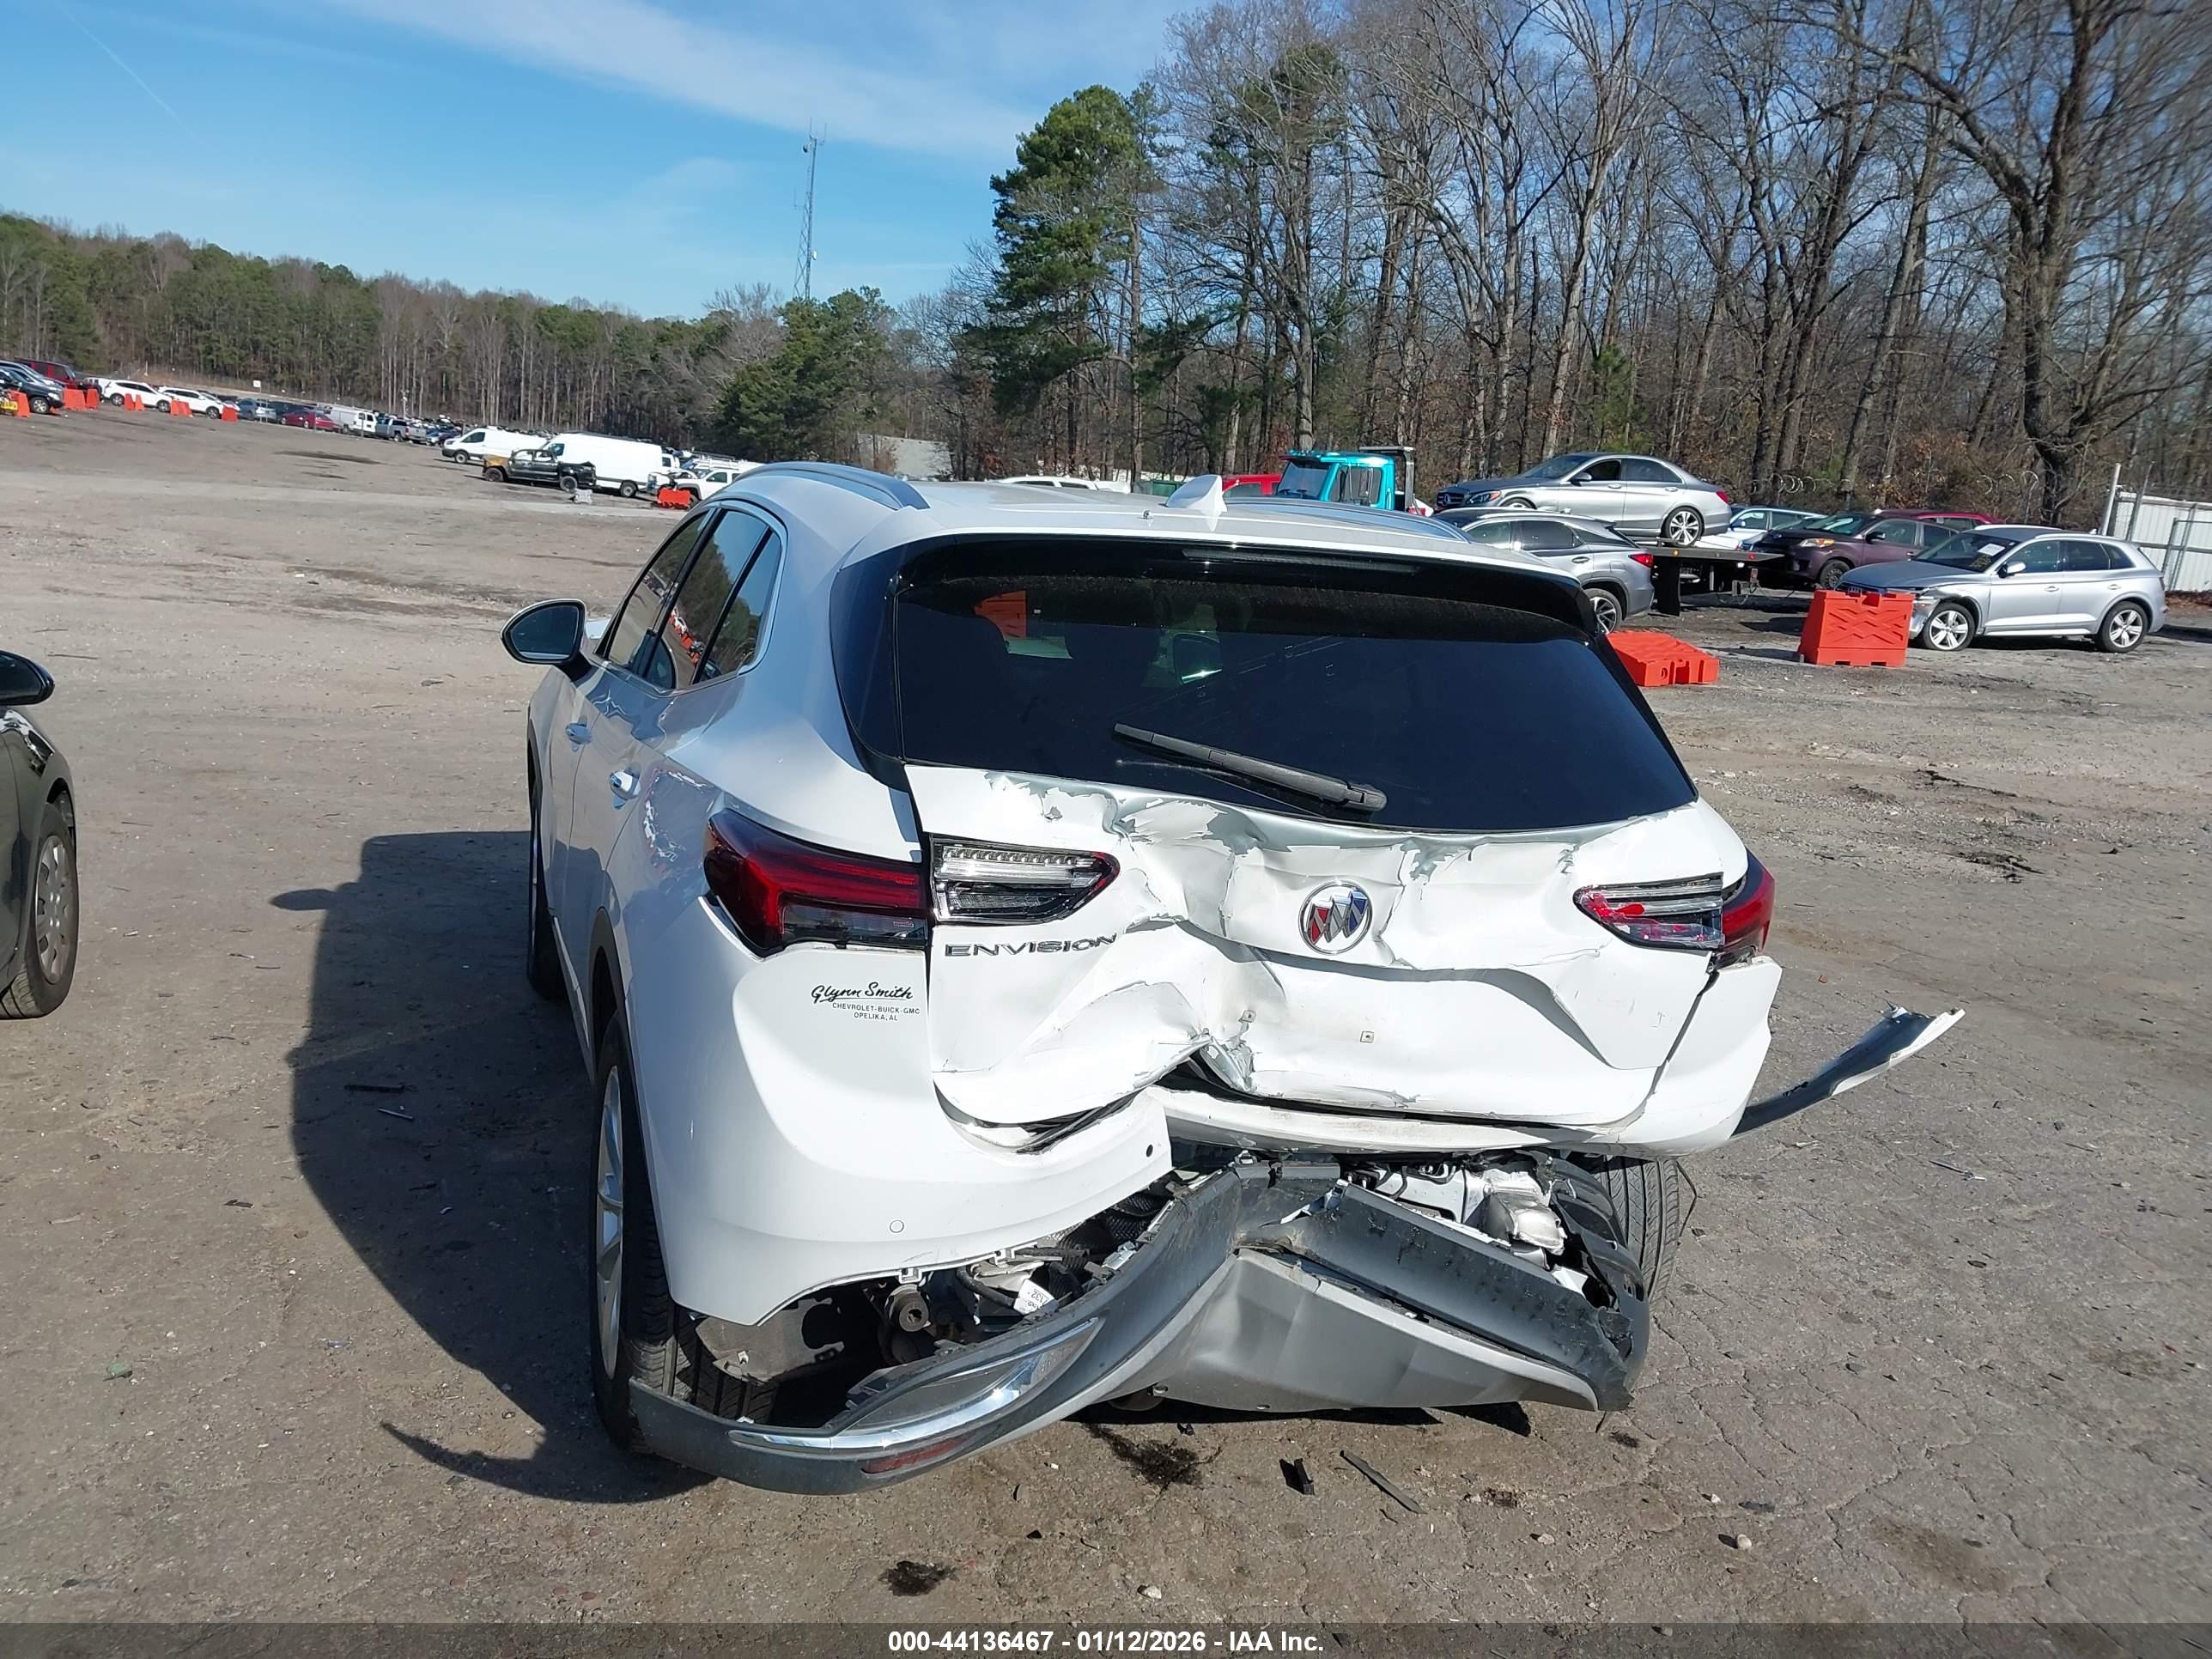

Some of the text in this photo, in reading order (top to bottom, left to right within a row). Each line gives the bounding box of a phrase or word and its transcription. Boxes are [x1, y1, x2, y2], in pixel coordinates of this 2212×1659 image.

[945, 932, 1117, 957] ENVISION
[811, 981, 913, 1004] Glynn Smith
